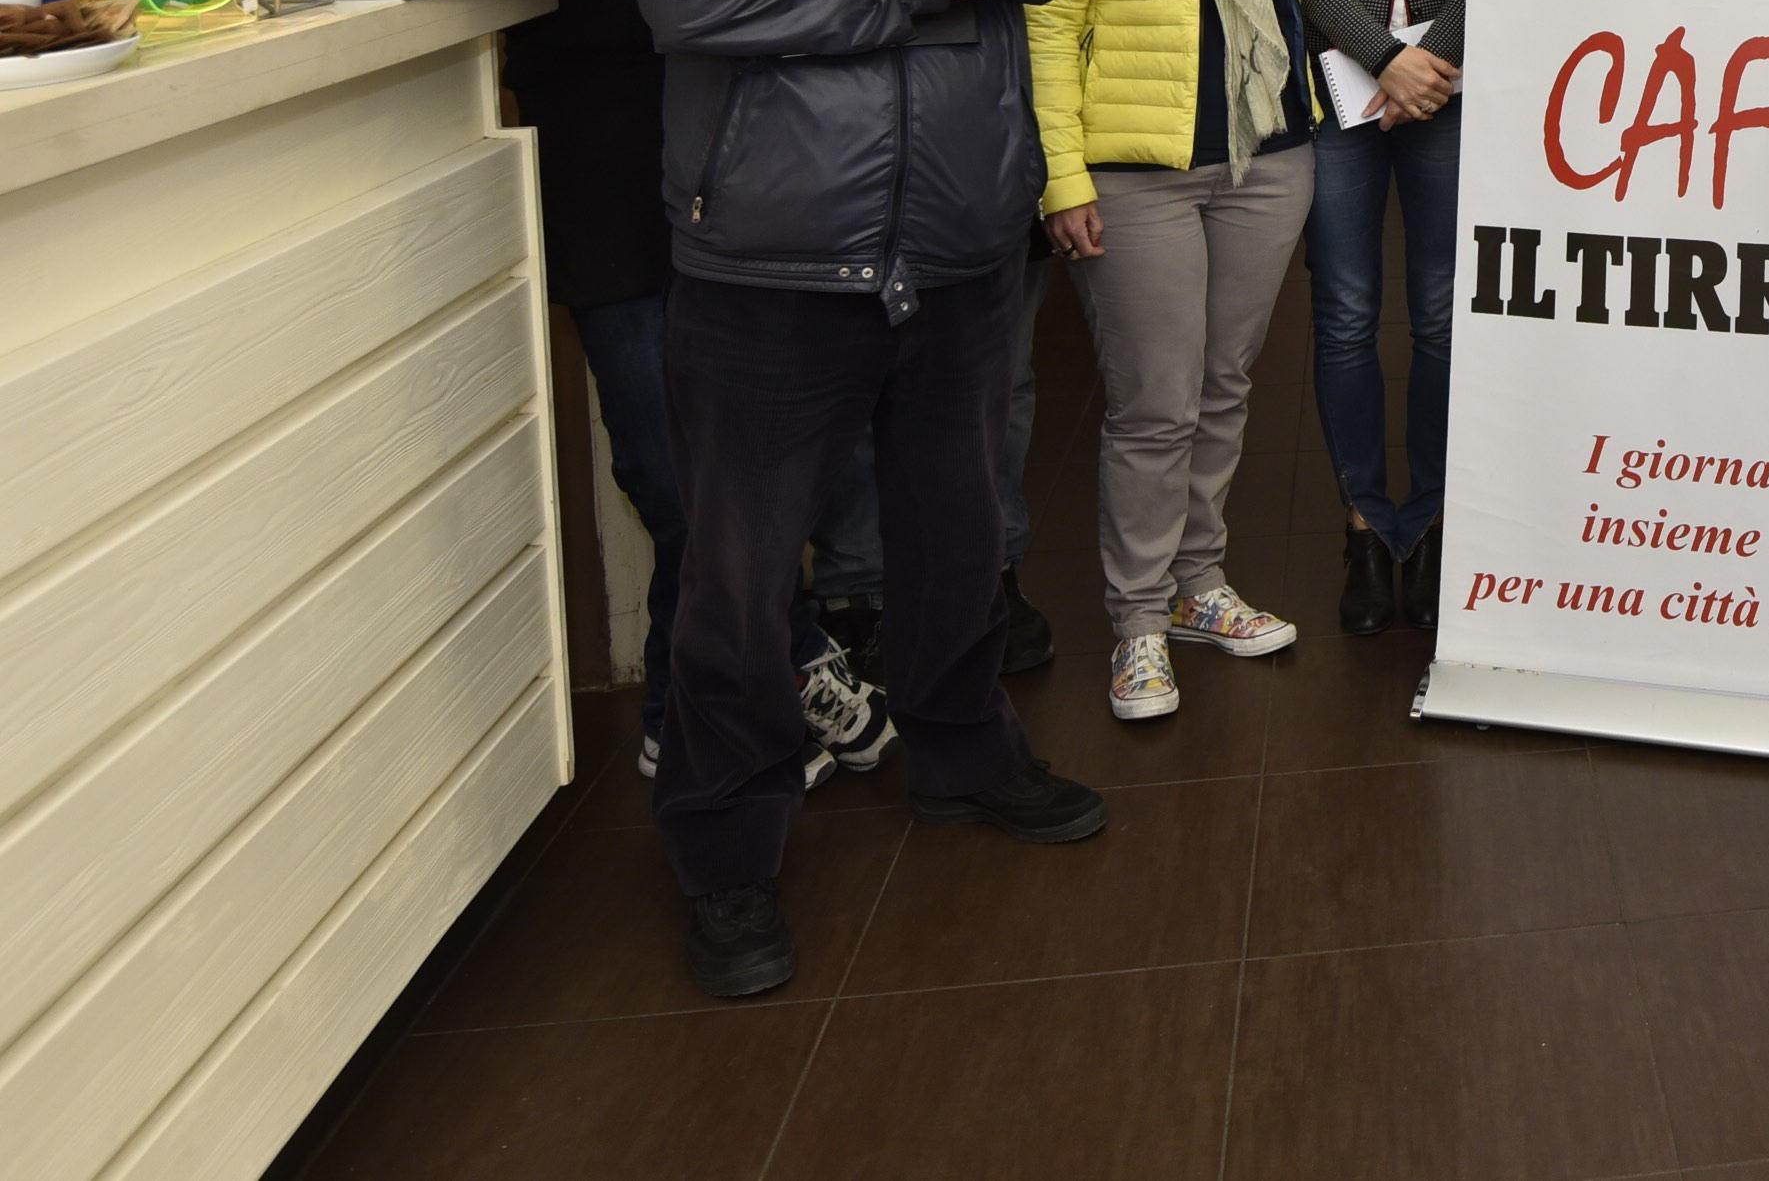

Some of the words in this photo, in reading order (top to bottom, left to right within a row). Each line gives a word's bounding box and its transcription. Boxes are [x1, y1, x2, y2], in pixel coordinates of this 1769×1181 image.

[1471, 225, 1556, 319] IL
[1582, 435, 1612, 474] I
[1581, 503, 1761, 557] insieme
[1463, 570, 1544, 611] per
[1556, 581, 1644, 616] una
[1660, 582, 1759, 628] città
